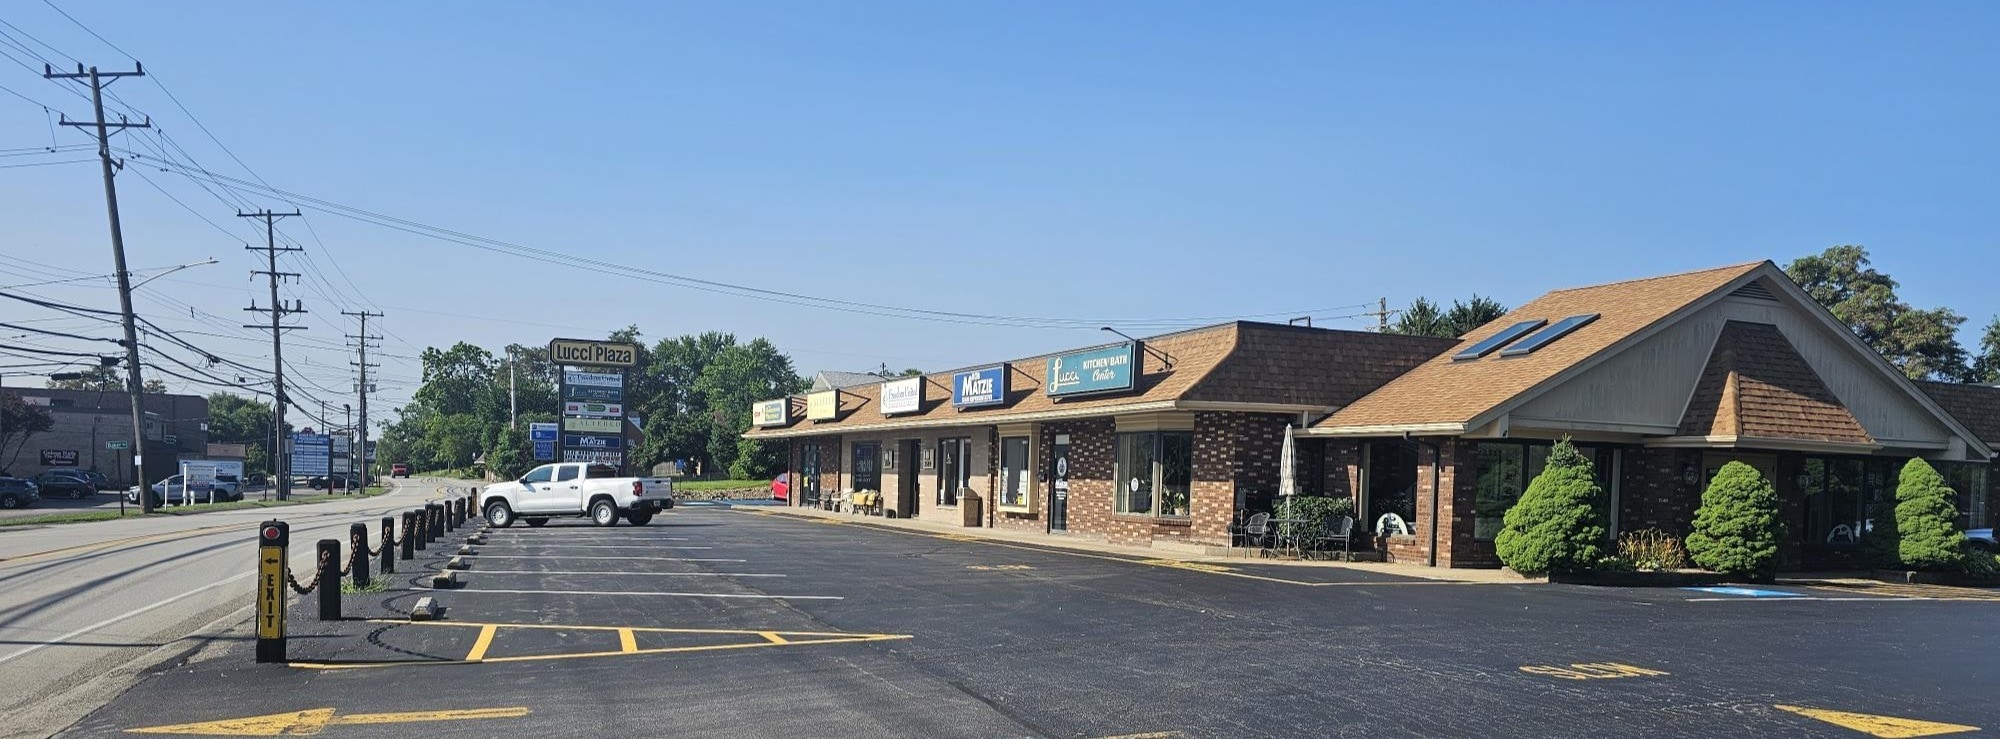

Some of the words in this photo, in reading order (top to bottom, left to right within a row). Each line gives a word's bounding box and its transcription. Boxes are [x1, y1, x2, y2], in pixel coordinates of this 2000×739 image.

[557, 344, 592, 361] Lucci
[596, 346, 631, 363] Plaza
[1082, 358, 1108, 370] KITCHEN
[1110, 354, 1128, 367] BATH
[1049, 357, 1080, 393] Lucci
[1092, 367, 1117, 381] Center
[961, 374, 993, 396] MATZIE
[580, 437, 606, 445] MATZIE
[266, 574, 275, 628] EXIT
